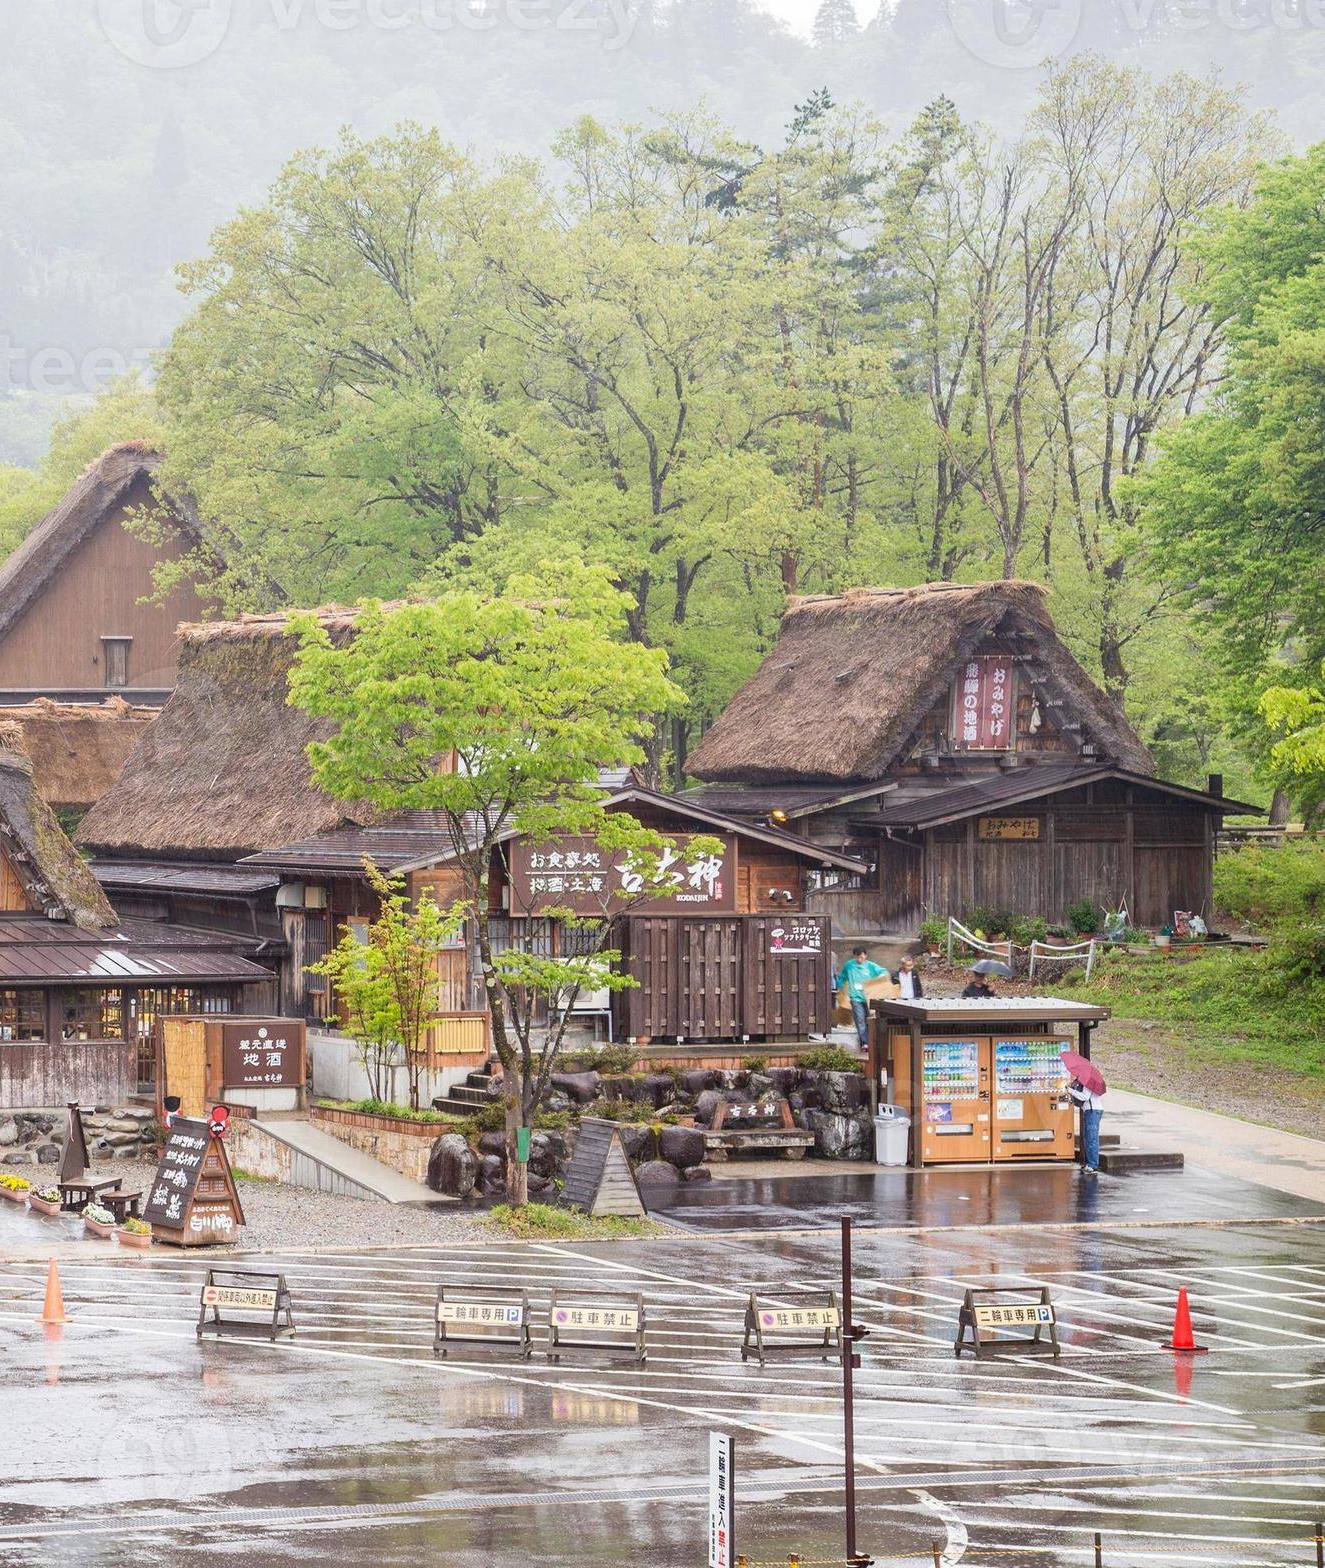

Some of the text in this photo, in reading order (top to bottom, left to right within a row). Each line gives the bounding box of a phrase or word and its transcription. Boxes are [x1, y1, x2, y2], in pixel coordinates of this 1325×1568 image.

[991, 668, 1006, 736] おみやげ
[530, 851, 601, 868] お食事処
[243, 1052, 282, 1067] 地酒
[443, 1307, 519, 1321] 二輪車専用 P
[570, 1311, 632, 1326] 駐車禁止
[776, 1311, 834, 1327] 駐車禁止
[980, 1308, 1048, 1322] 二輪車専用 P
